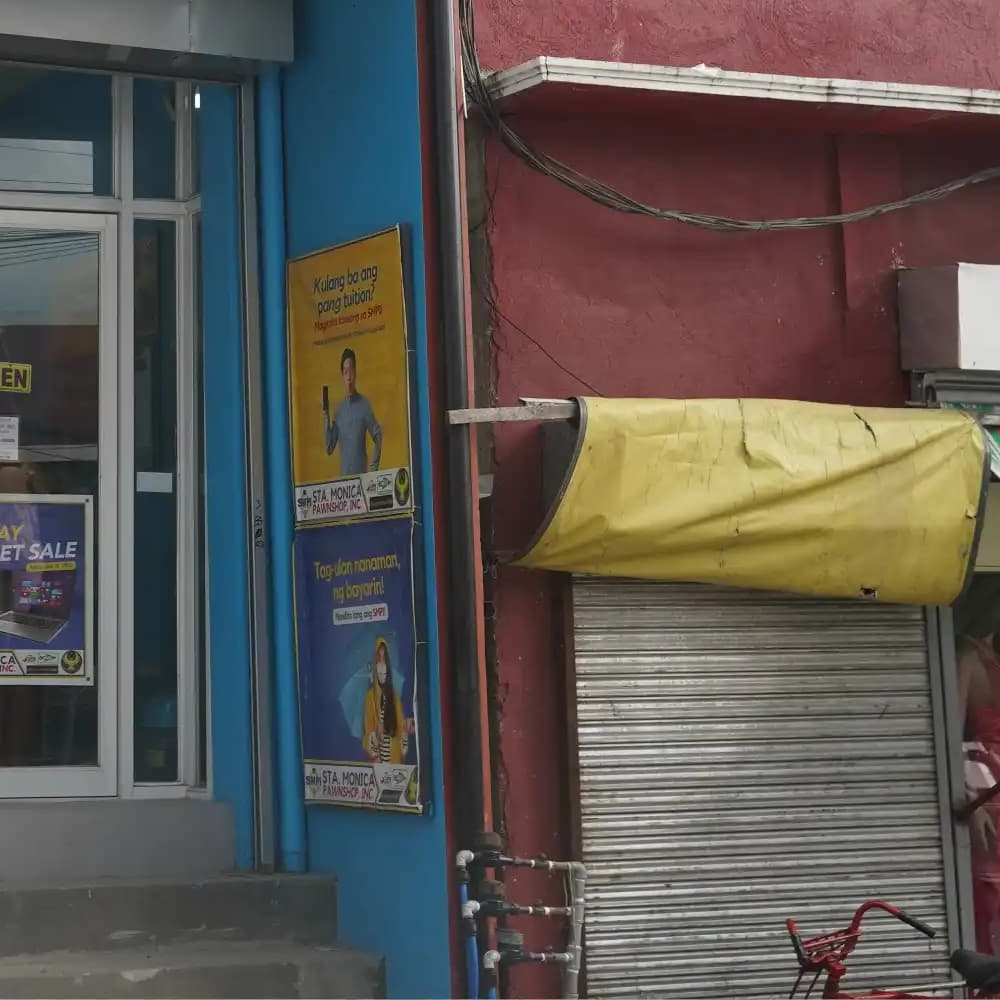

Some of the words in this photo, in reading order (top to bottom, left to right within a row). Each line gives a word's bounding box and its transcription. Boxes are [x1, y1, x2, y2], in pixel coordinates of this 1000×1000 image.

[313, 274, 345, 295] Kulang
[347, 267, 359, 285] ba
[360, 265, 378, 282] ang
[317, 297, 341, 316] pang
[343, 283, 375, 307] tuition?
[330, 485, 361, 501] MONICA
[28, 541, 78, 561] SALE
[354, 553, 400, 571] nanaman,
[345, 576, 385, 600] bayarin!
[0, 665, 16, 673] INC.
[342, 771, 375, 787] MONICA
